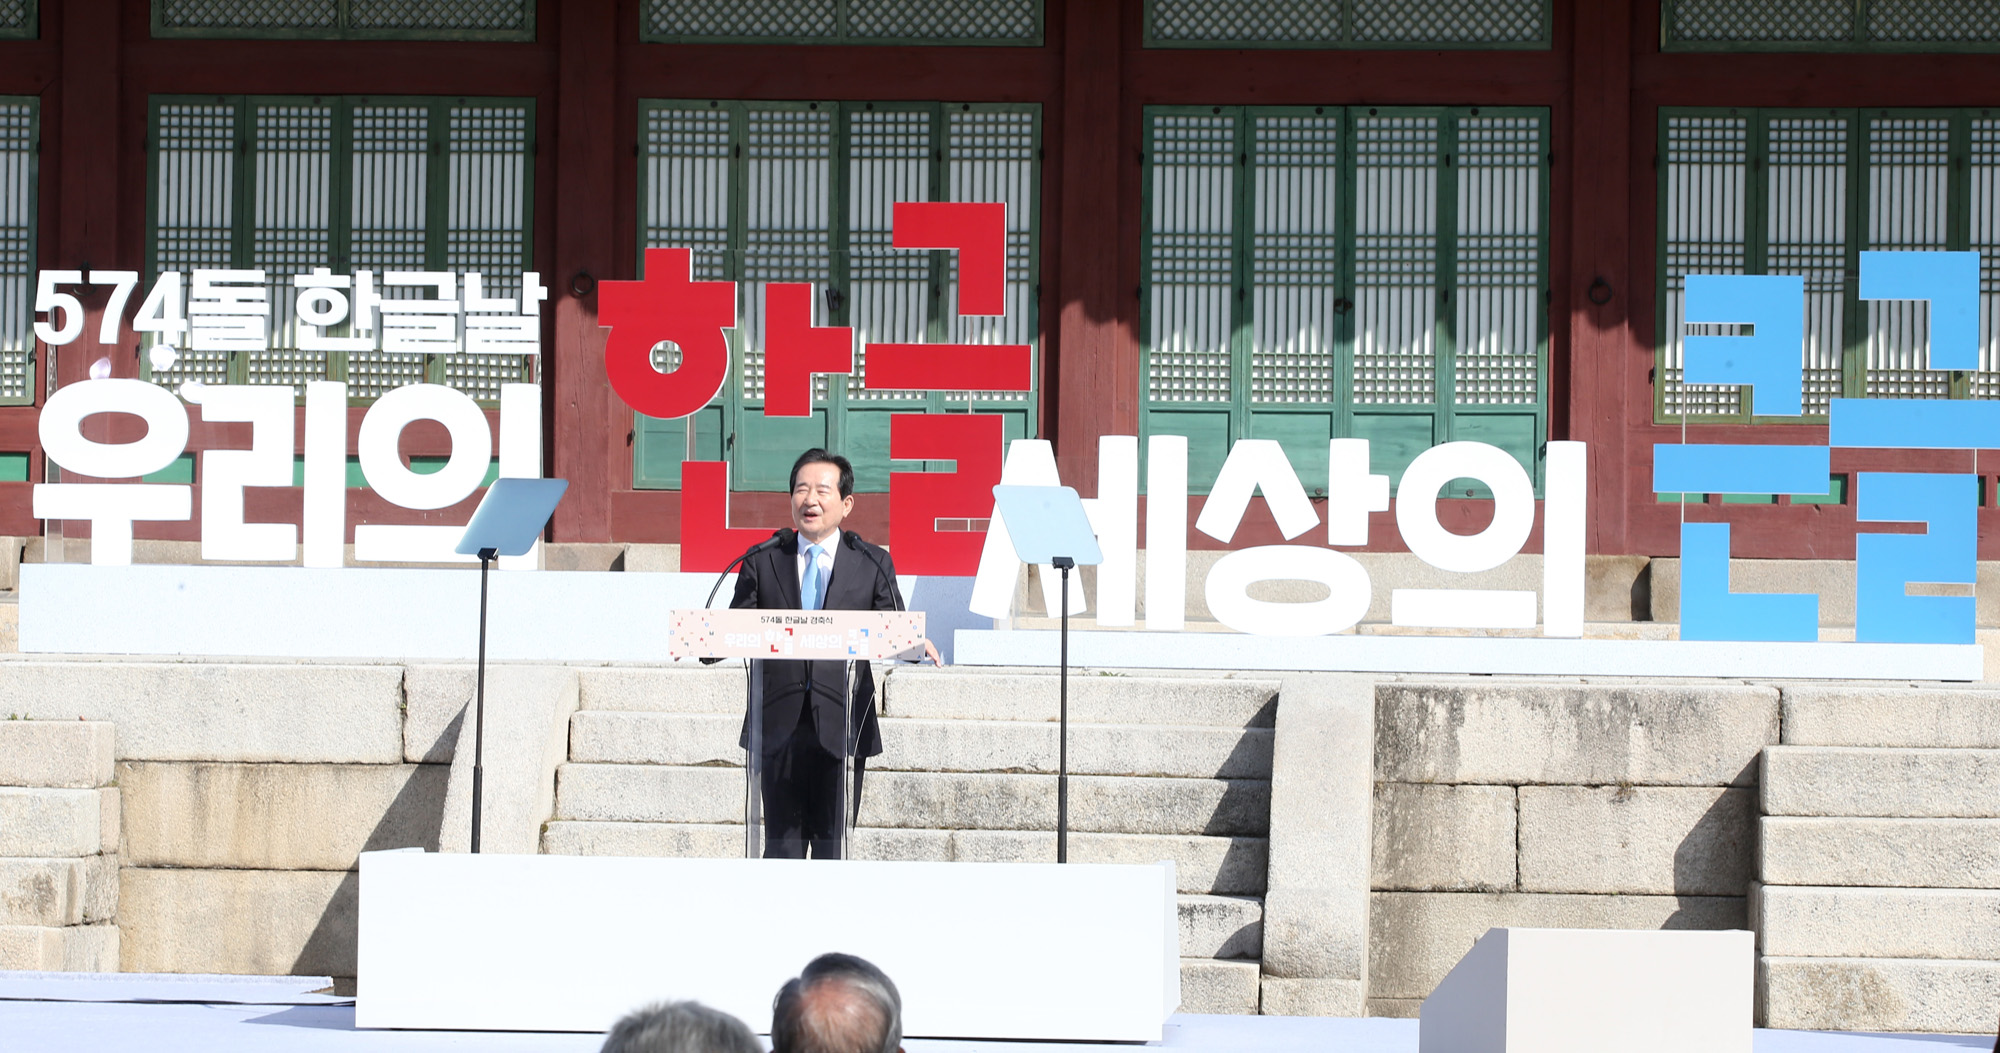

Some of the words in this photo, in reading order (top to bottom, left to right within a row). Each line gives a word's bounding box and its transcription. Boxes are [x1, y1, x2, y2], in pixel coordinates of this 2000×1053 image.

[33, 269, 270, 351] 574돌
[294, 267, 548, 354] 한글날
[33, 378, 541, 571] 우리의
[597, 202, 1033, 576] 한글
[968, 435, 1587, 637] 세상의
[1653, 251, 2000, 645] 큰글
[724, 632, 761, 648] 우리의
[800, 633, 842, 649] 세상의
[760, 615, 783, 624] 574돌
[785, 615, 808, 624] 한글날
[810, 615, 833, 625] 경축식
